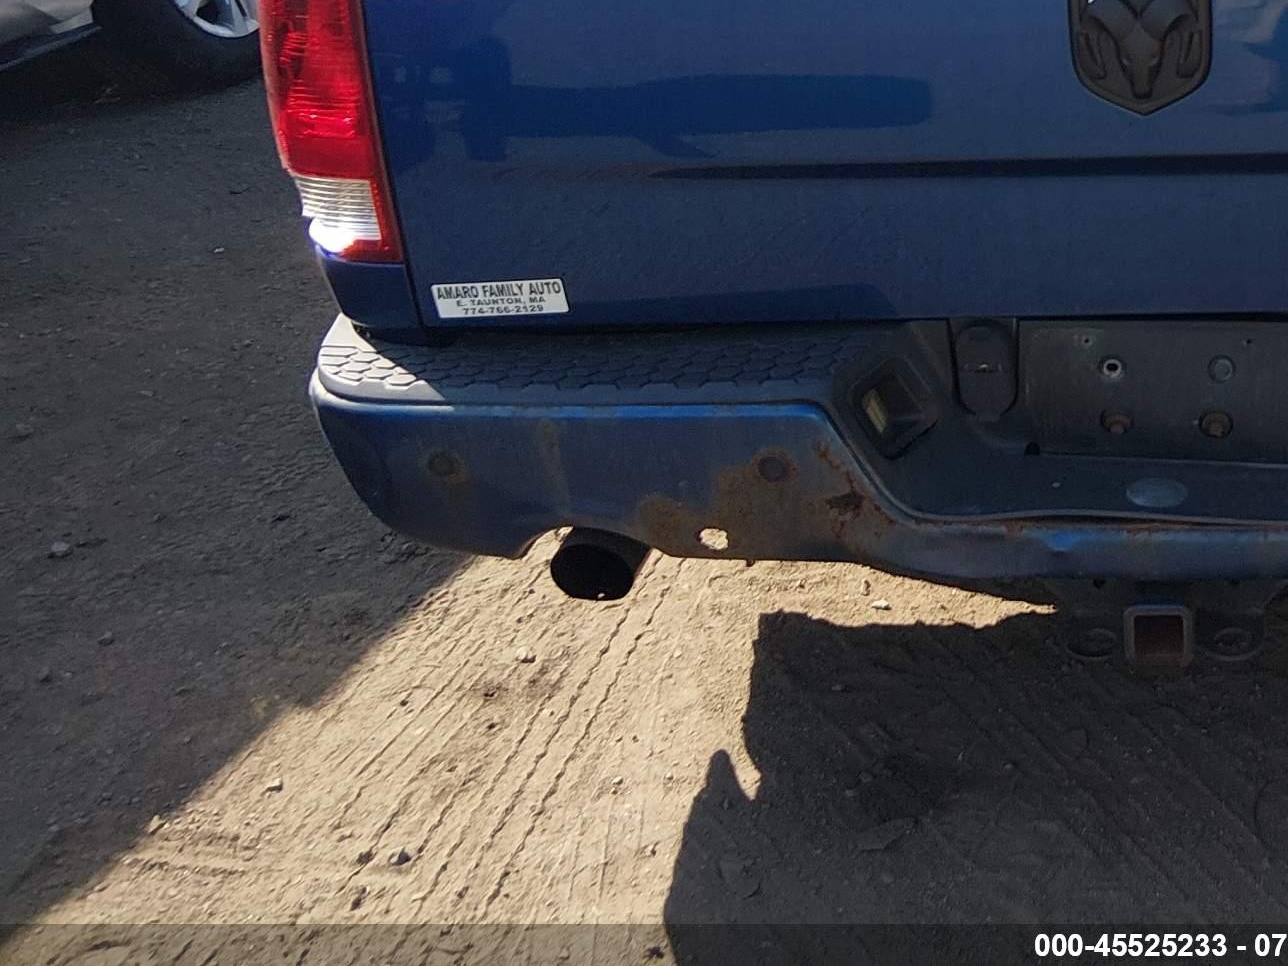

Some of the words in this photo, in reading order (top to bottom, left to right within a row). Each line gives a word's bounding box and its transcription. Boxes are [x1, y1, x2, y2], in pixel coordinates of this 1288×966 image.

[436, 286, 479, 300] AMARO
[481, 283, 524, 298] FAMILY
[529, 281, 562, 295] AUTO
[529, 295, 546, 304] MA
